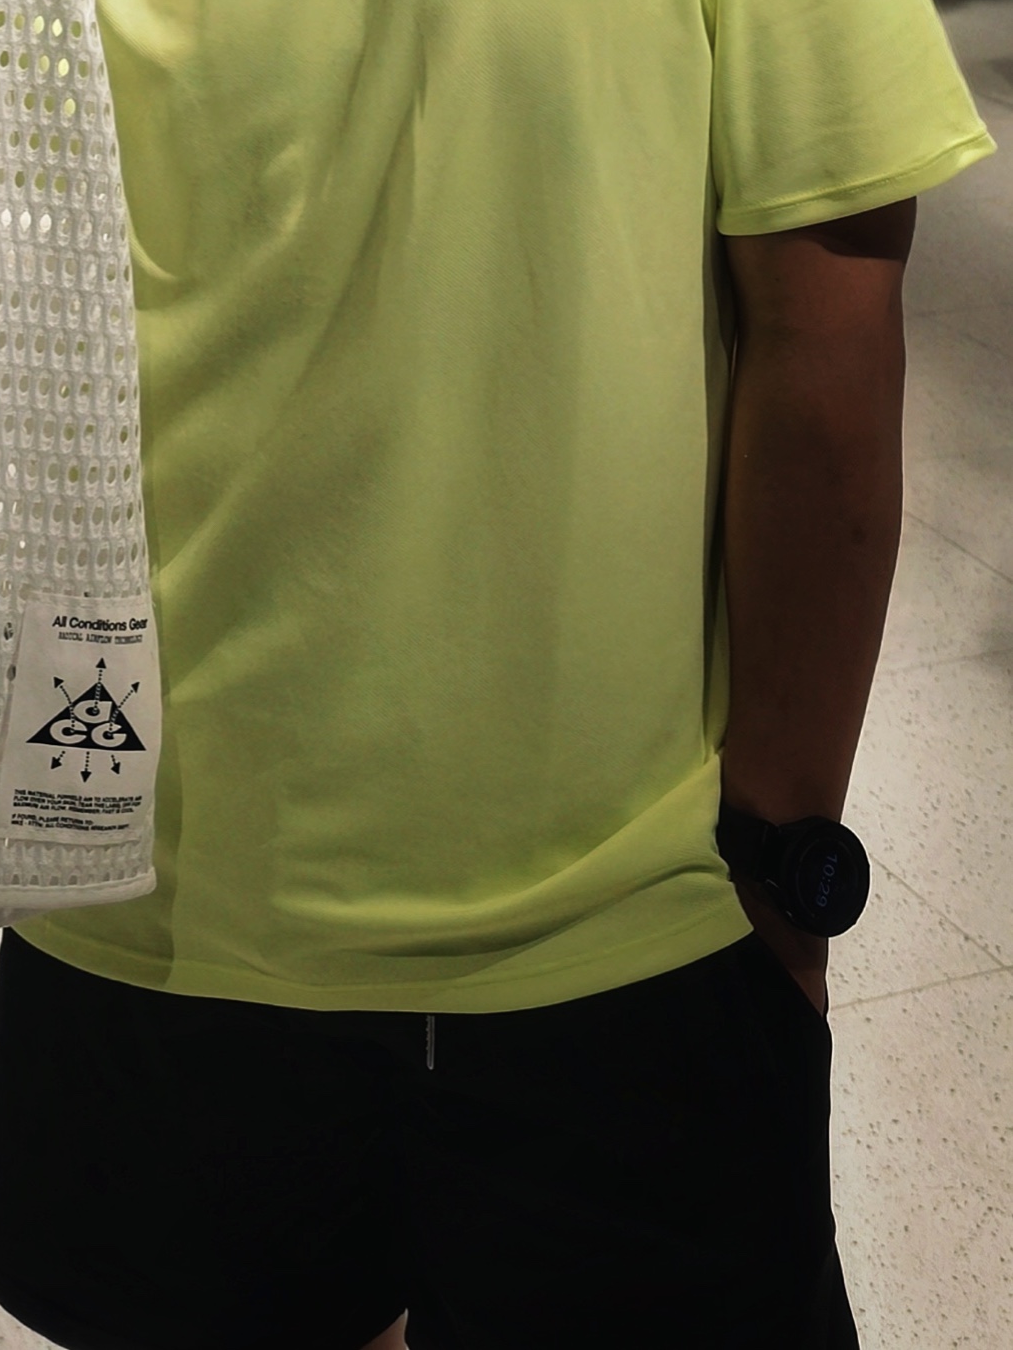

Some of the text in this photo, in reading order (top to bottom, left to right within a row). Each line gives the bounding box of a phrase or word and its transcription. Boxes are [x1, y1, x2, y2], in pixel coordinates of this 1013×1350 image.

[52, 615, 148, 632] All Conditions Gear
[816, 854, 837, 907] 10:29
